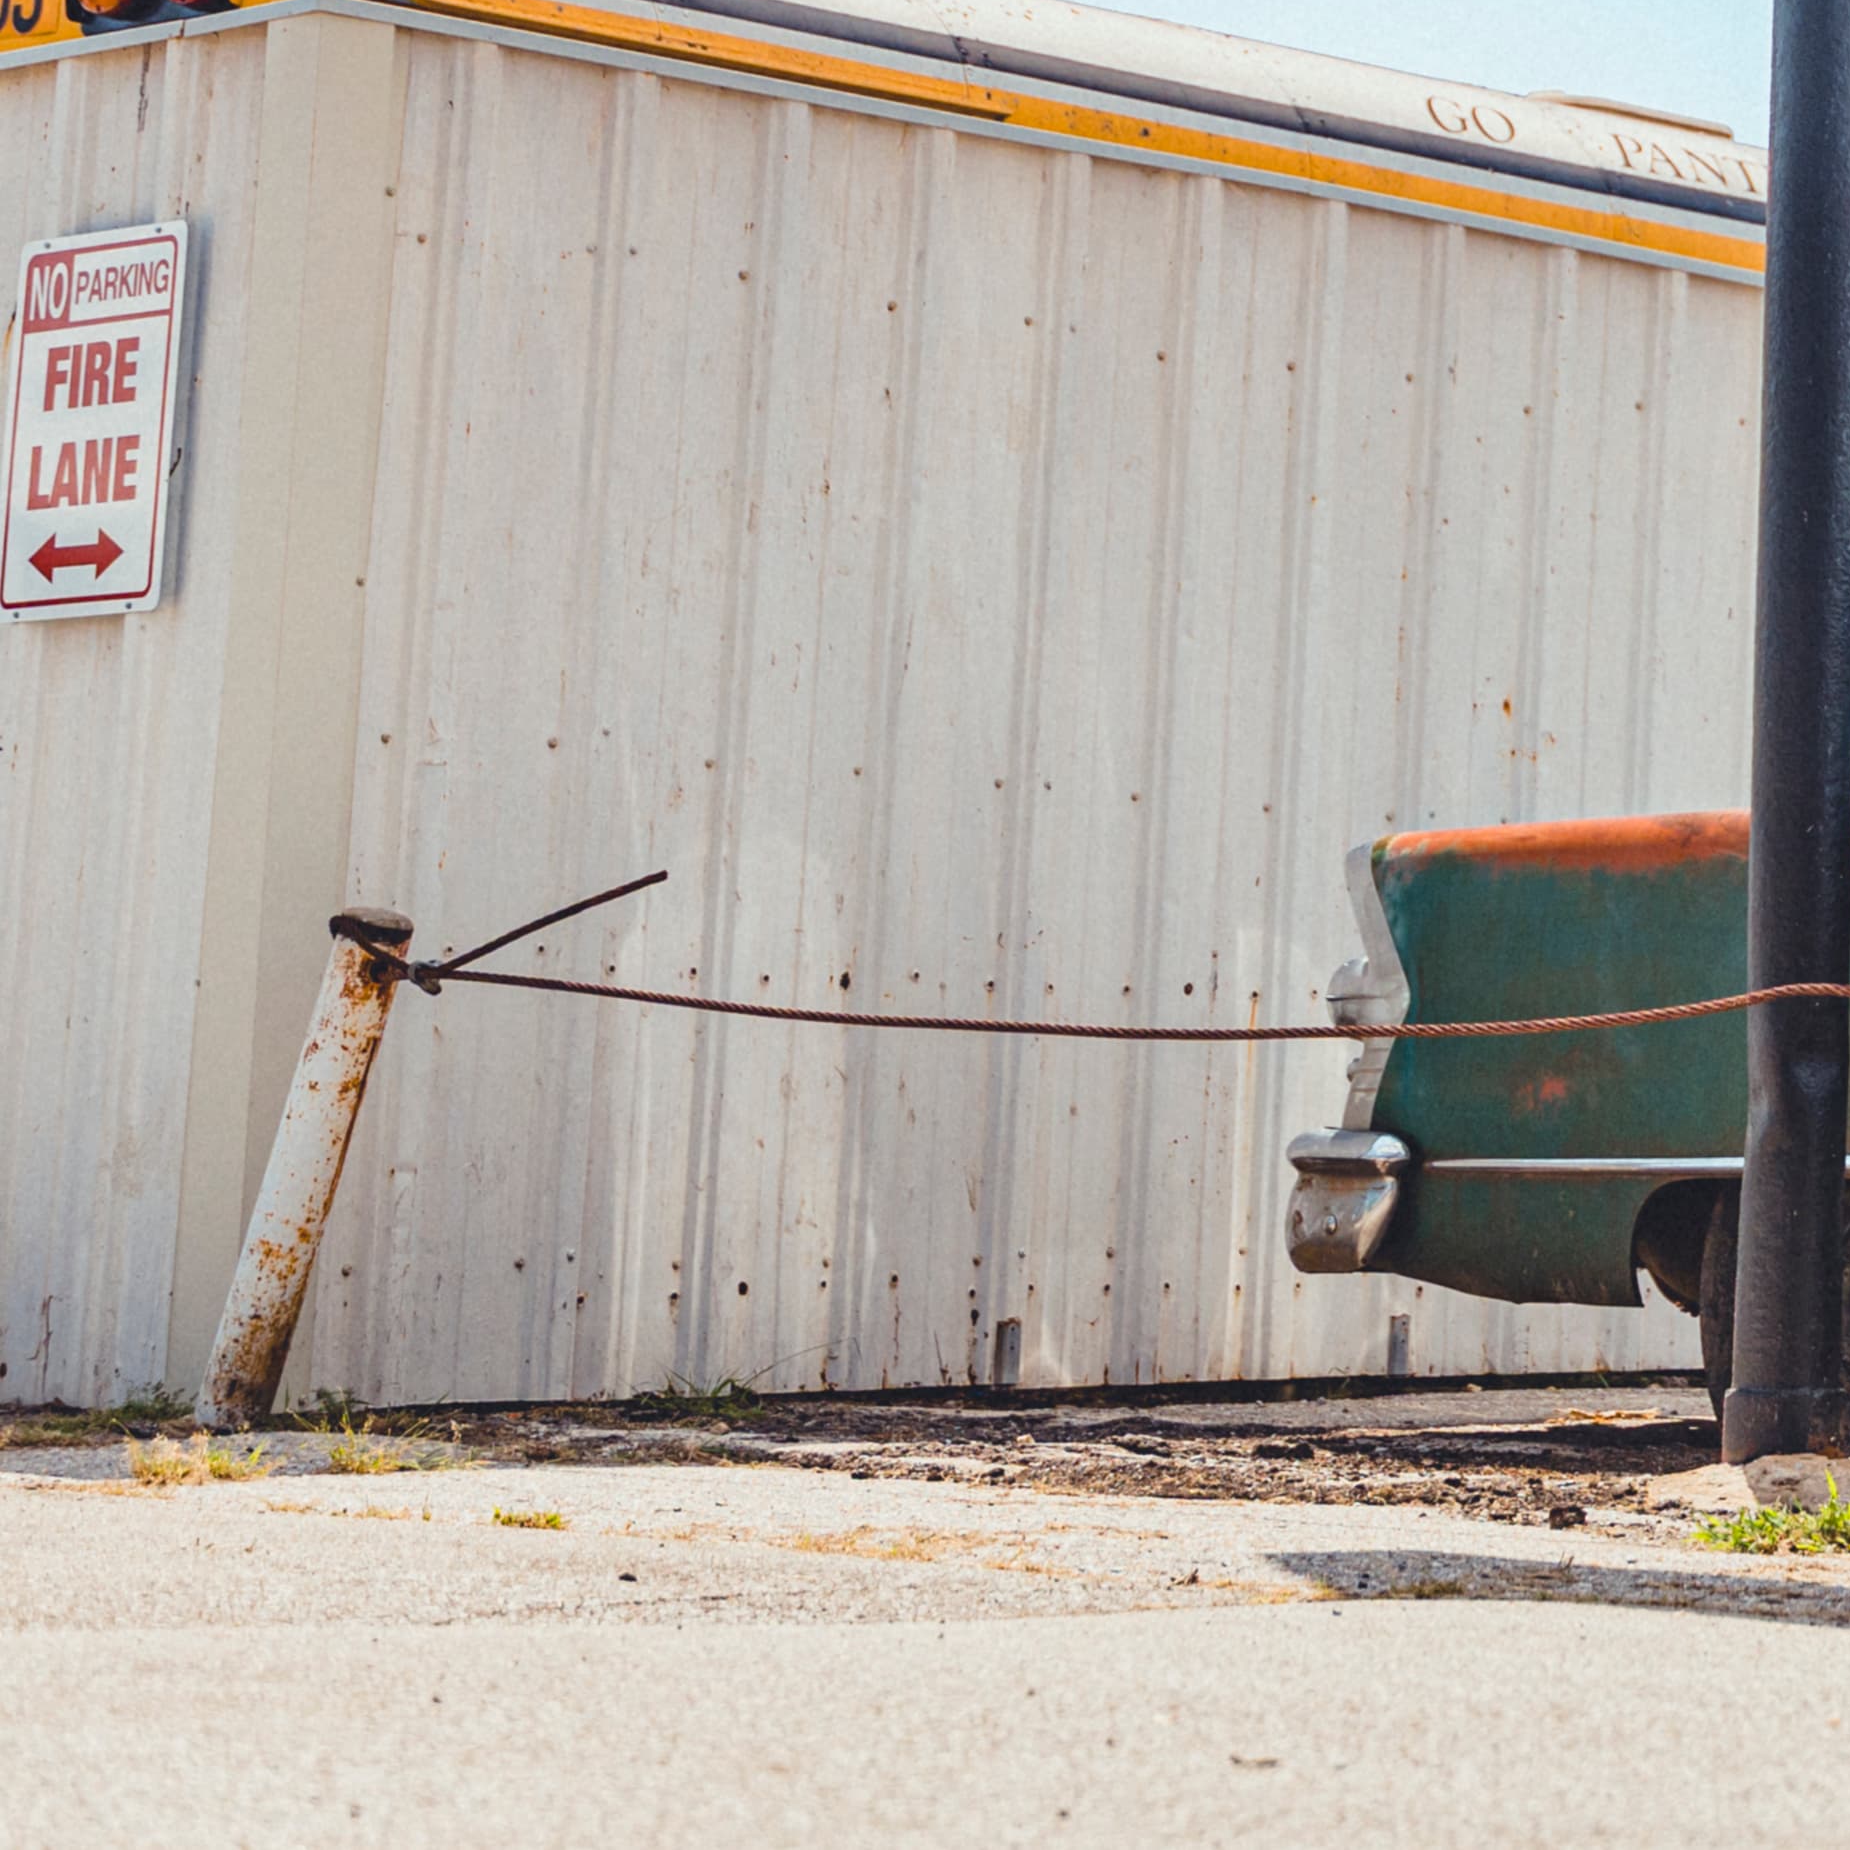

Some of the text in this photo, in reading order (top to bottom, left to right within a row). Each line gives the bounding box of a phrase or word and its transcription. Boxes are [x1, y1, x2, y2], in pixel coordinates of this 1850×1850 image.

[1426, 94, 1516, 144] GO
[29, 258, 170, 322] NO PARKING
[43, 336, 140, 412] FIRE
[26, 434, 140, 511] LANE
